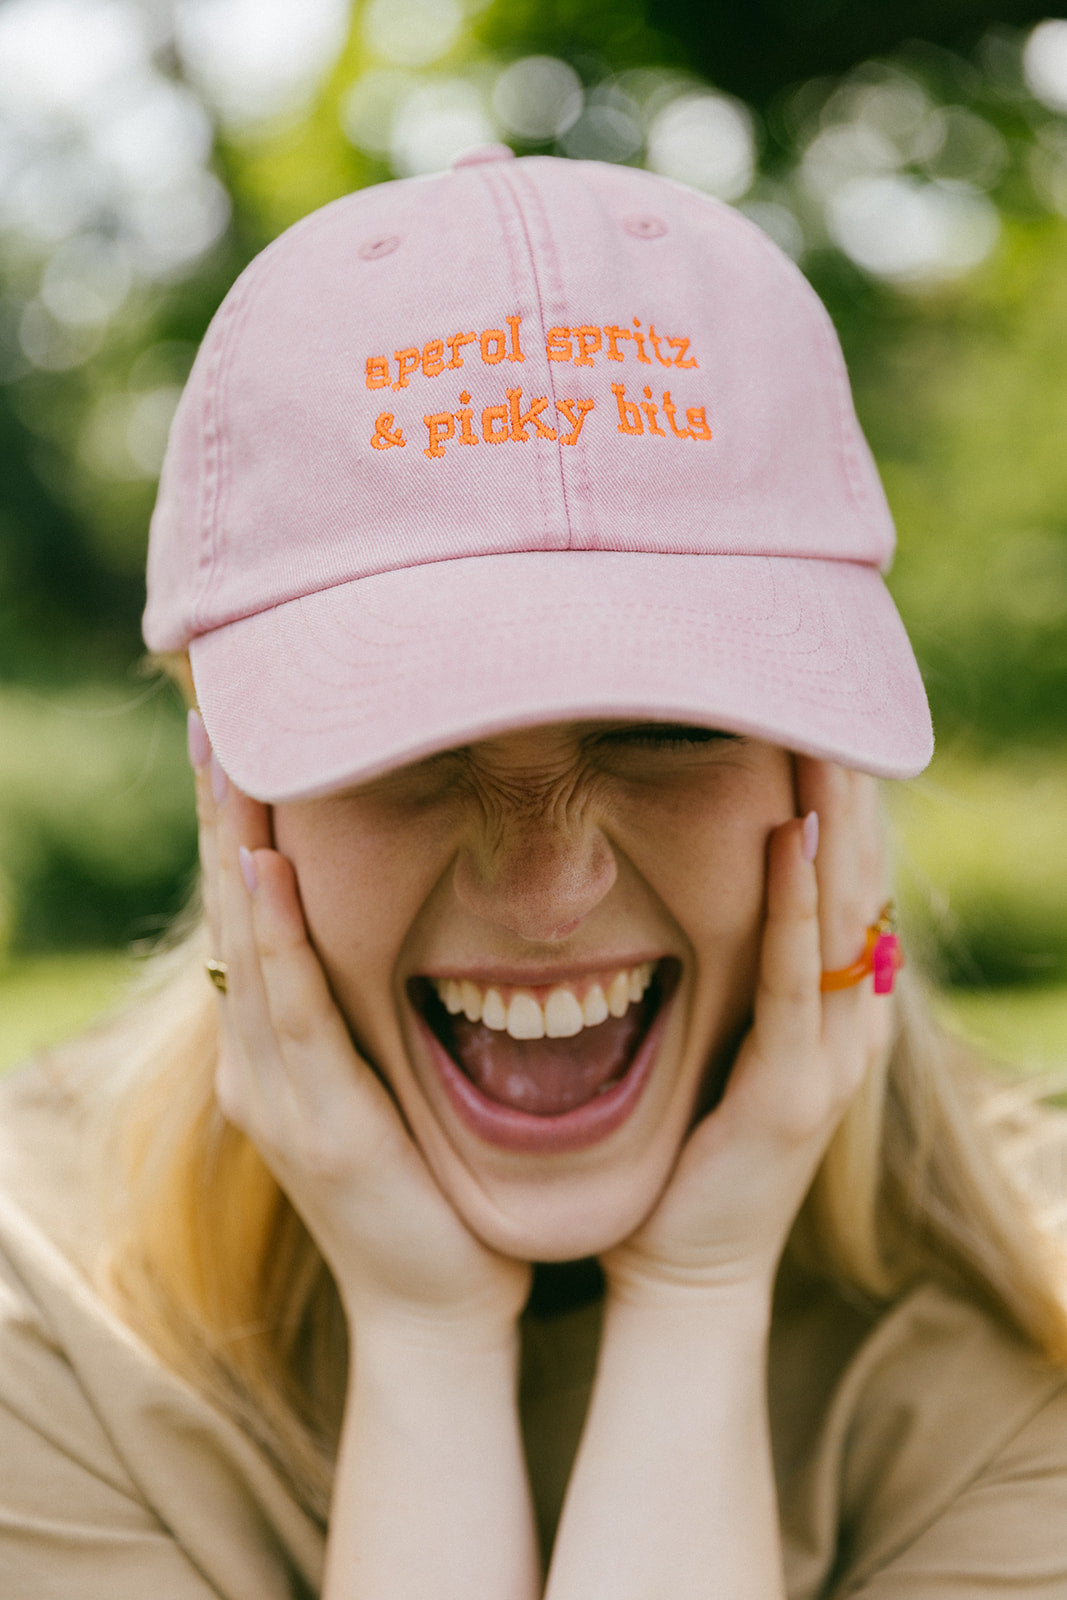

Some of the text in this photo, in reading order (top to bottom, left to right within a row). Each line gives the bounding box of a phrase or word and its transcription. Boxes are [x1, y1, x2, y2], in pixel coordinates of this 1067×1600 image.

[364, 315, 699, 392] aperol spritz
[370, 382, 713, 460] & picky bits
